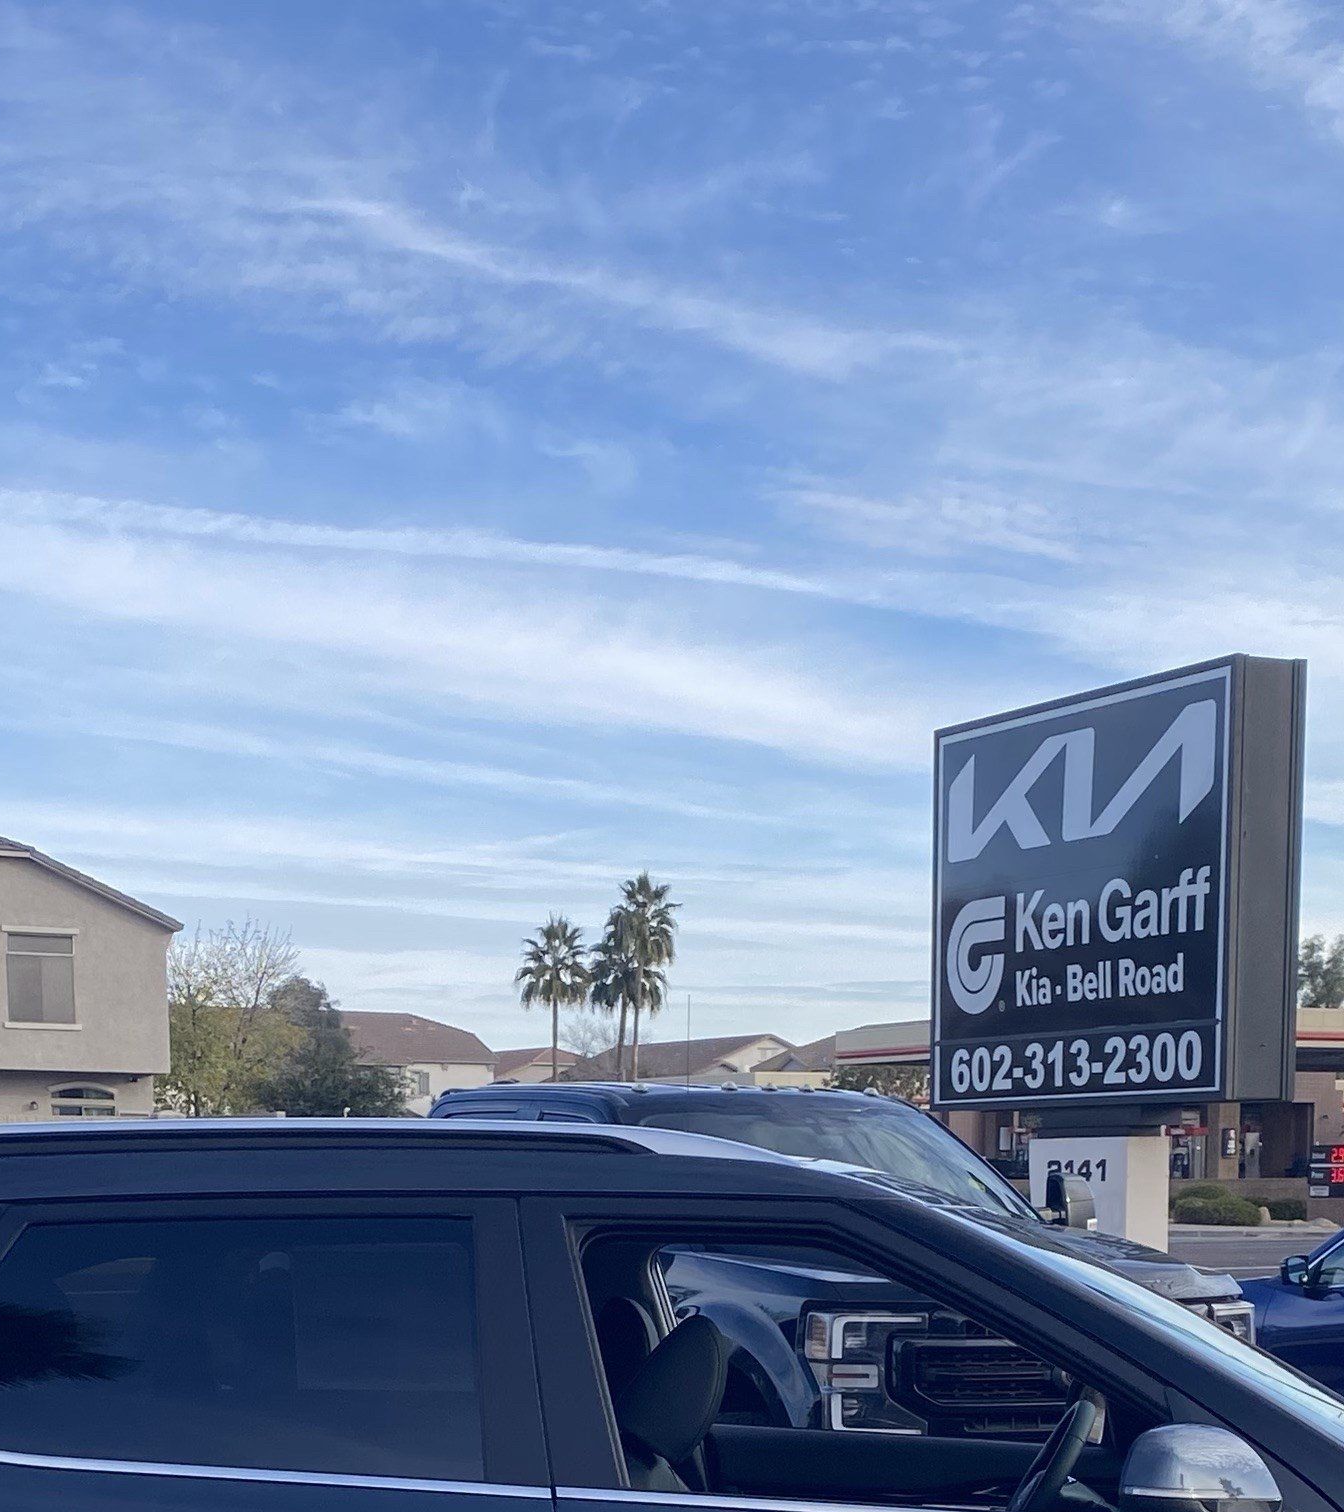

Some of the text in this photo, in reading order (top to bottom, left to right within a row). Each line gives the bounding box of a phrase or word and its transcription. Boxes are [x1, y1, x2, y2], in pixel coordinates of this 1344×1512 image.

[947, 699, 1217, 863] KIA
[1015, 866, 1211, 953] Ken Garff
[1015, 966, 1052, 1007] Kia
[1066, 960, 1112, 1002] Bell
[1118, 952, 1184, 998] Road
[951, 1030, 1203, 1094] 602-313-2300
[1047, 1159, 1107, 1182] 2141
